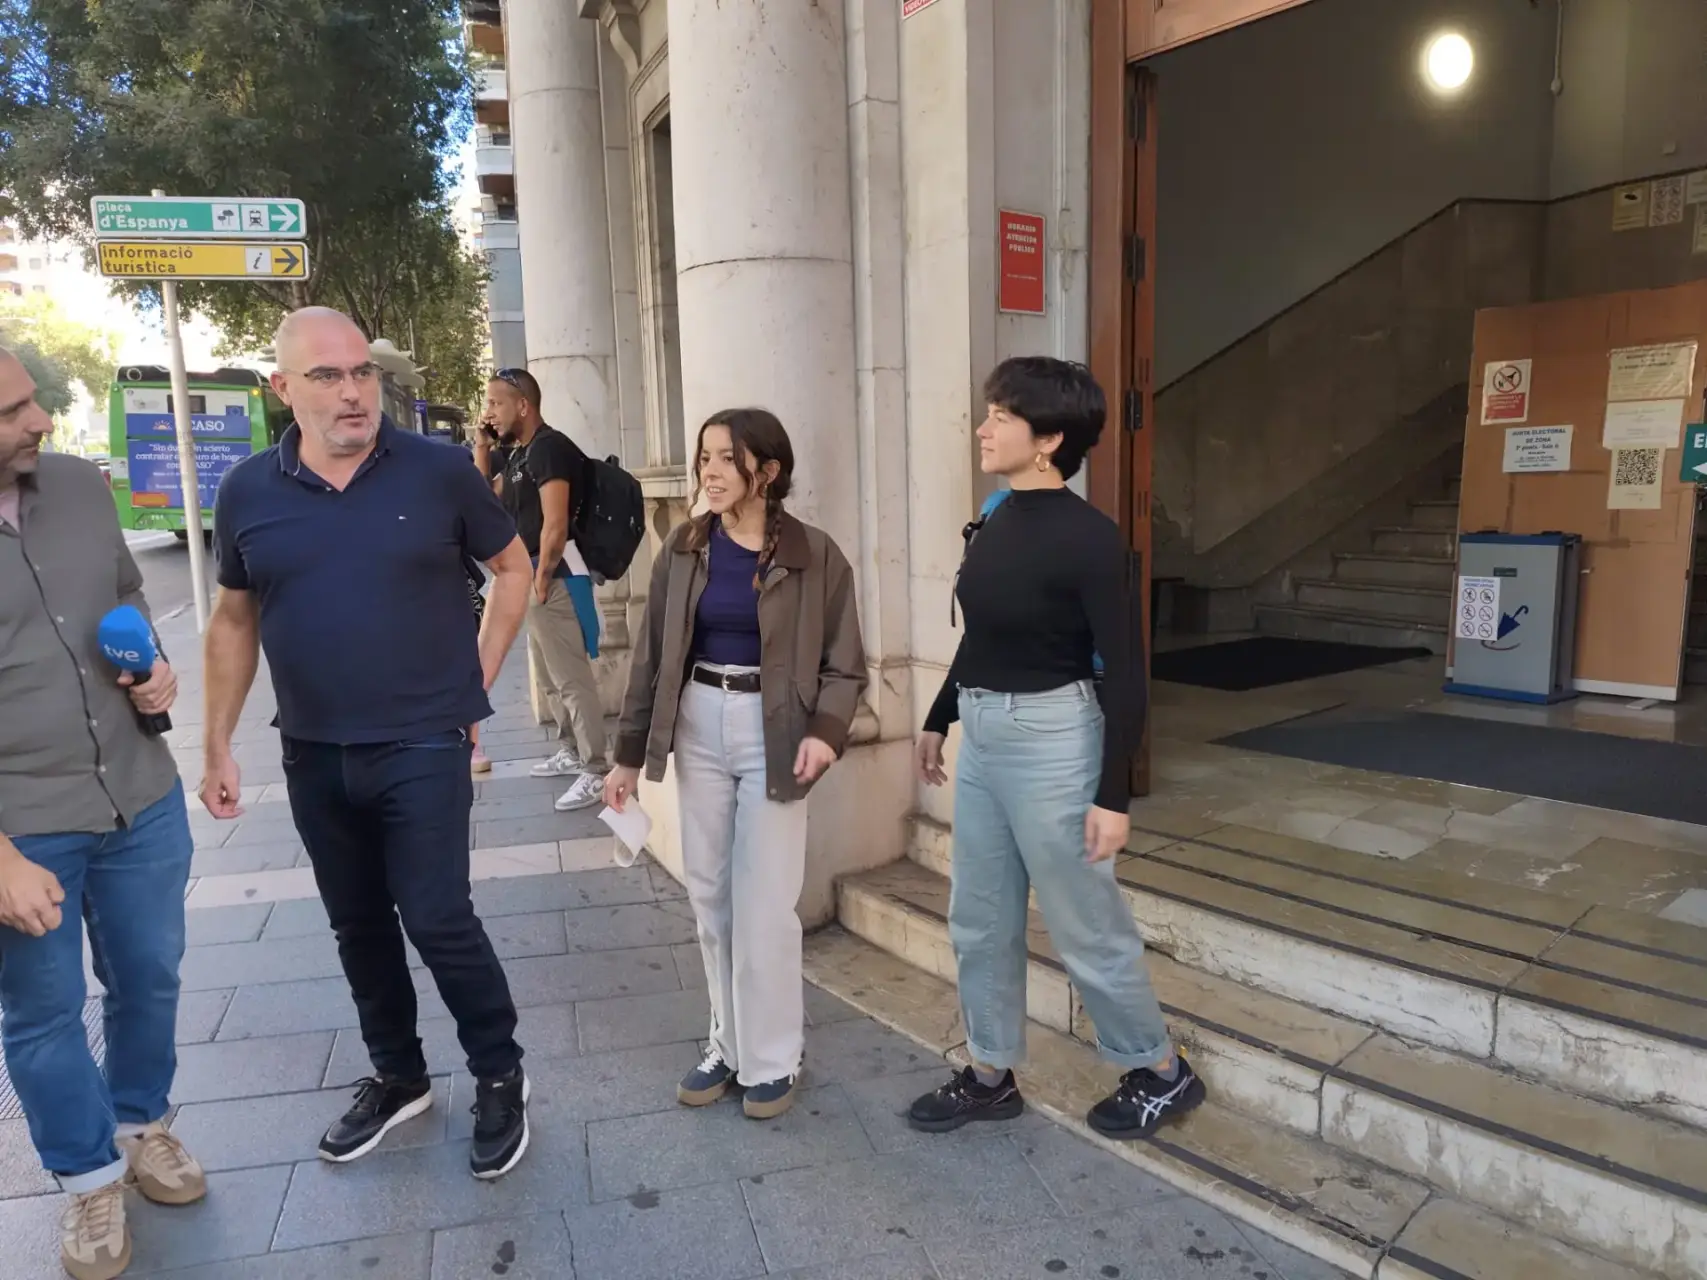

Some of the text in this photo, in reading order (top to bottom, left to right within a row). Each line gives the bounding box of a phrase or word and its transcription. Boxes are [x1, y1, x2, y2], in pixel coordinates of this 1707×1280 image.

[98, 203, 132, 213] plaça
[100, 215, 188, 230] d'Espanya
[103, 246, 193, 258] informació
[103, 643, 141, 662] tve
